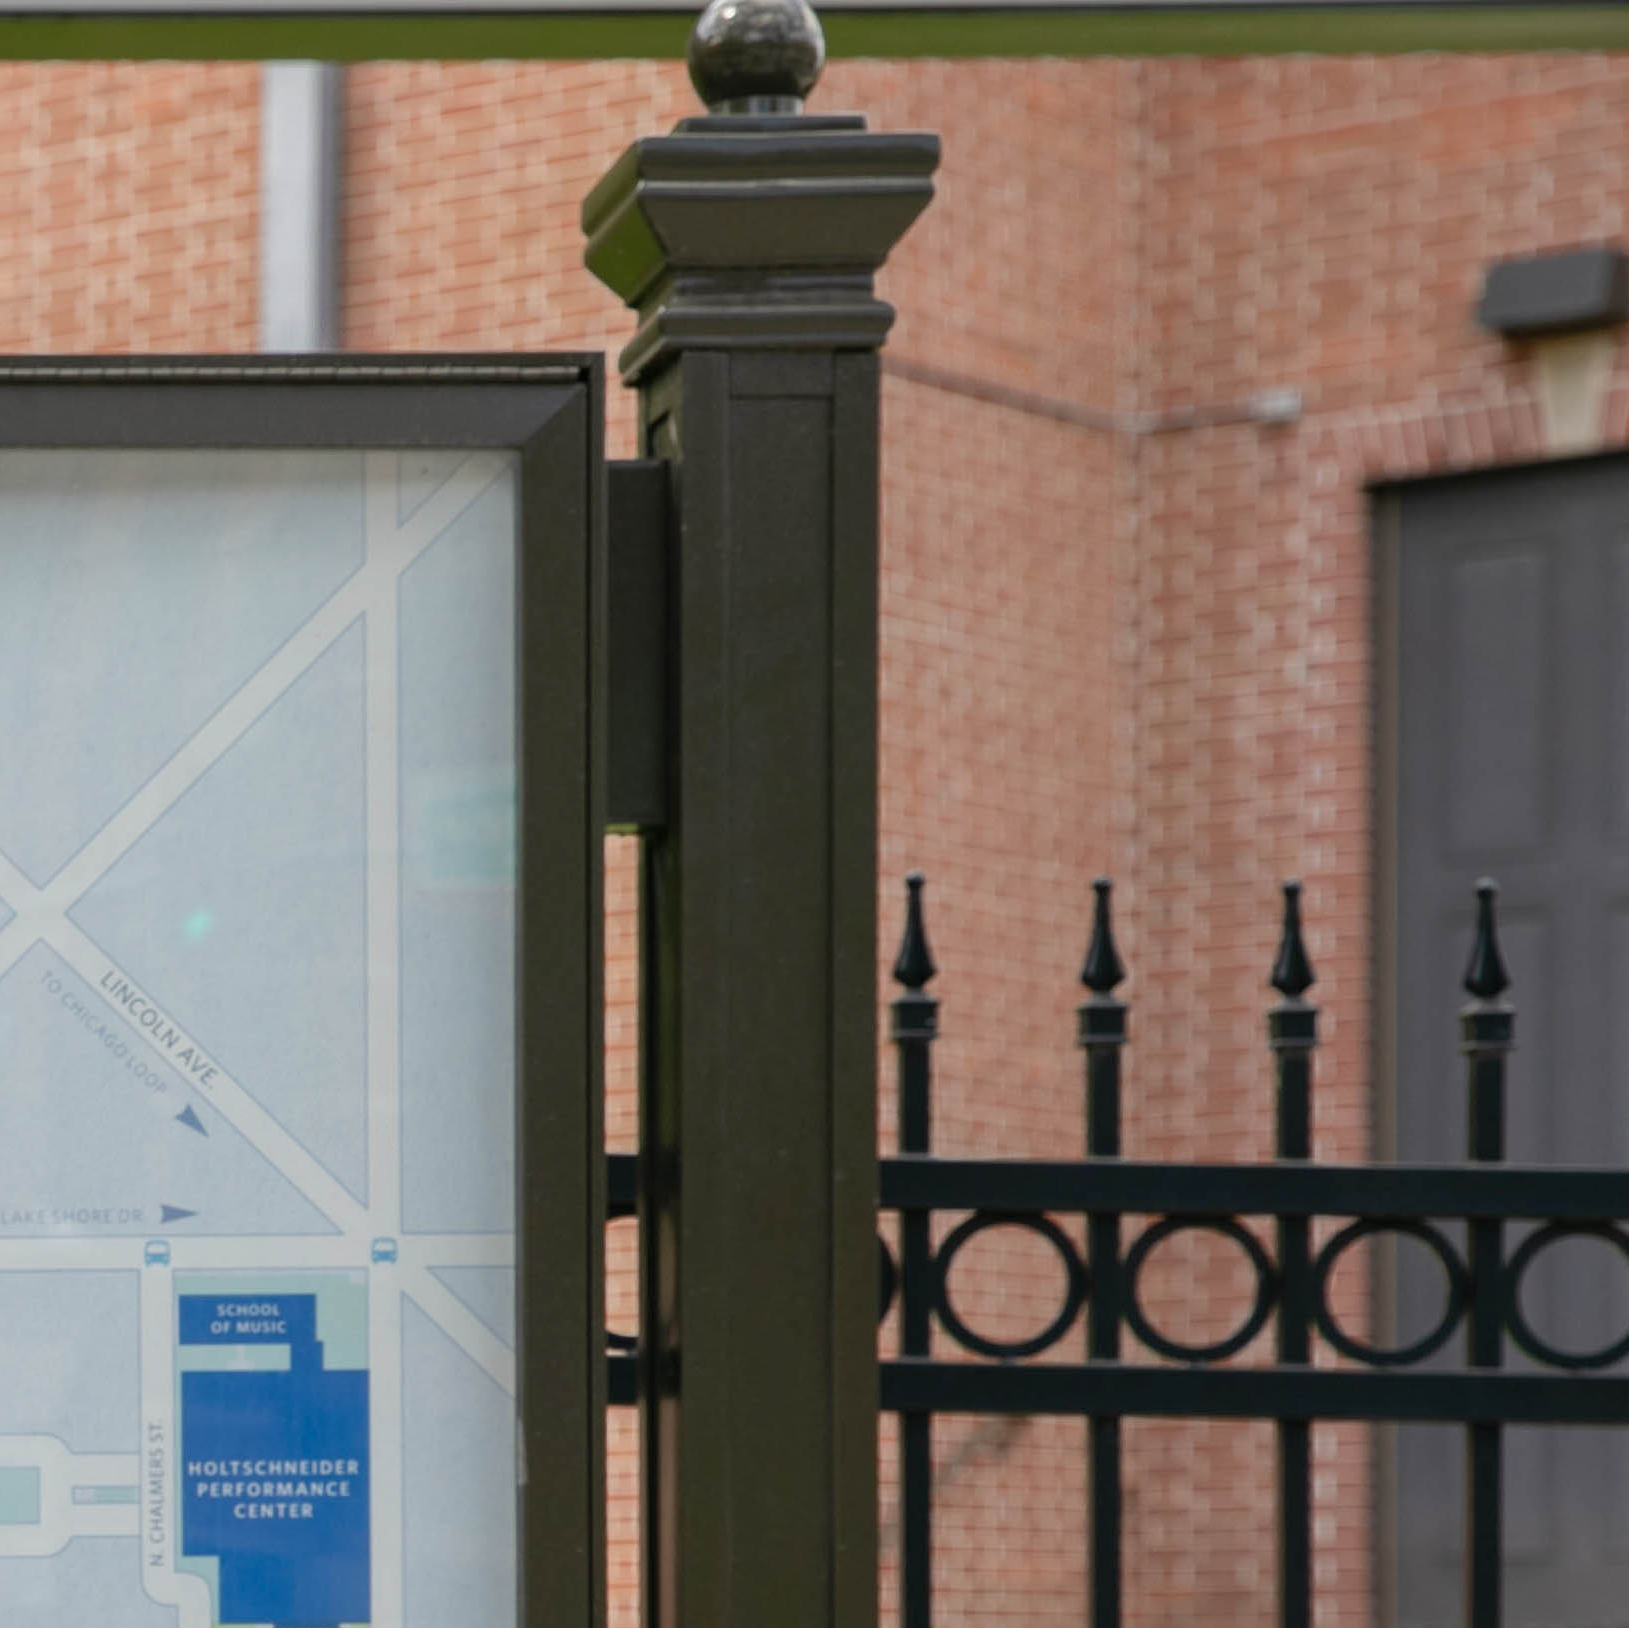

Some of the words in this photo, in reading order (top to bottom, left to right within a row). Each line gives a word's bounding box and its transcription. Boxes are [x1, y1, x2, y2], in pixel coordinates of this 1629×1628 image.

[100, 970, 181, 1049] LINCOLN
[177, 1048, 219, 1090] AVE.
[62, 992, 128, 1058] CHICAGO
[125, 1056, 168, 1093] LOOP
[0, 1209, 44, 1224] LAKE
[52, 1208, 112, 1224] SHORE
[216, 1303, 280, 1317] SCHOOL
[211, 1320, 231, 1334] OF
[236, 1320, 287, 1334] MUSIC
[188, 1460, 360, 1477] HOLTSCHNEIDER
[149, 1446, 164, 1544] CHALMERS
[196, 1481, 351, 1498] PERFORMANCE
[233, 1502, 313, 1519] CENTER
